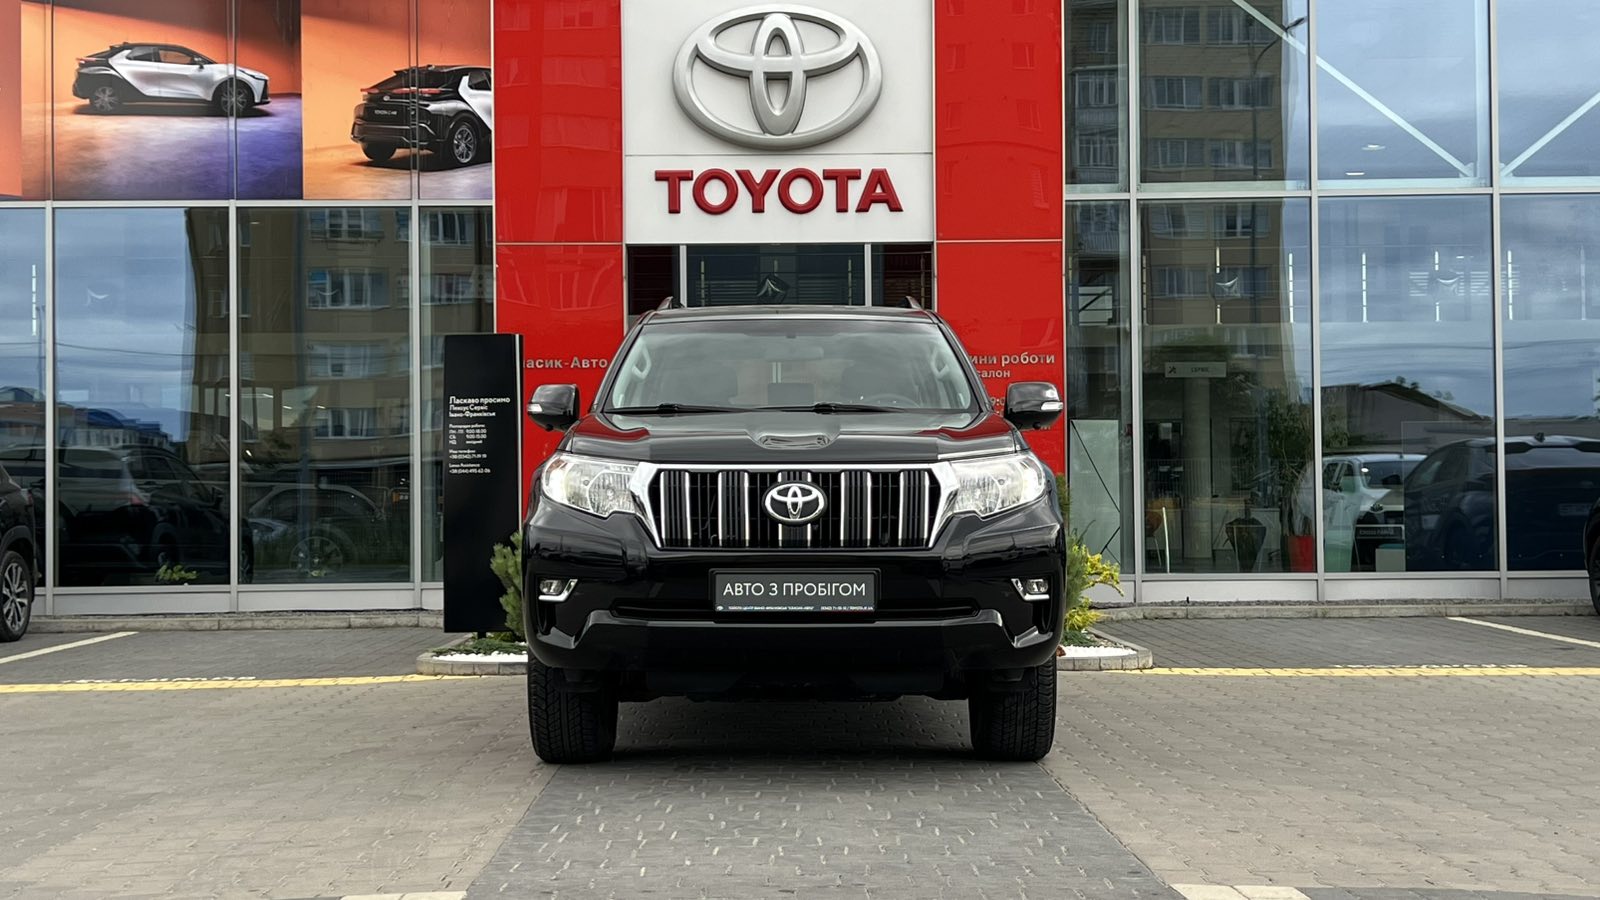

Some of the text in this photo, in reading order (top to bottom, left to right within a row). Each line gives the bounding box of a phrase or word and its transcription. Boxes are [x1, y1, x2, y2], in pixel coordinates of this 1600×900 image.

[655, 168, 903, 215] TOYOTA
[523, 356, 608, 369] асик-Авто
[1001, 352, 1055, 367] роботи
[723, 583, 866, 596] АВТО З ПРОБІГОМ
